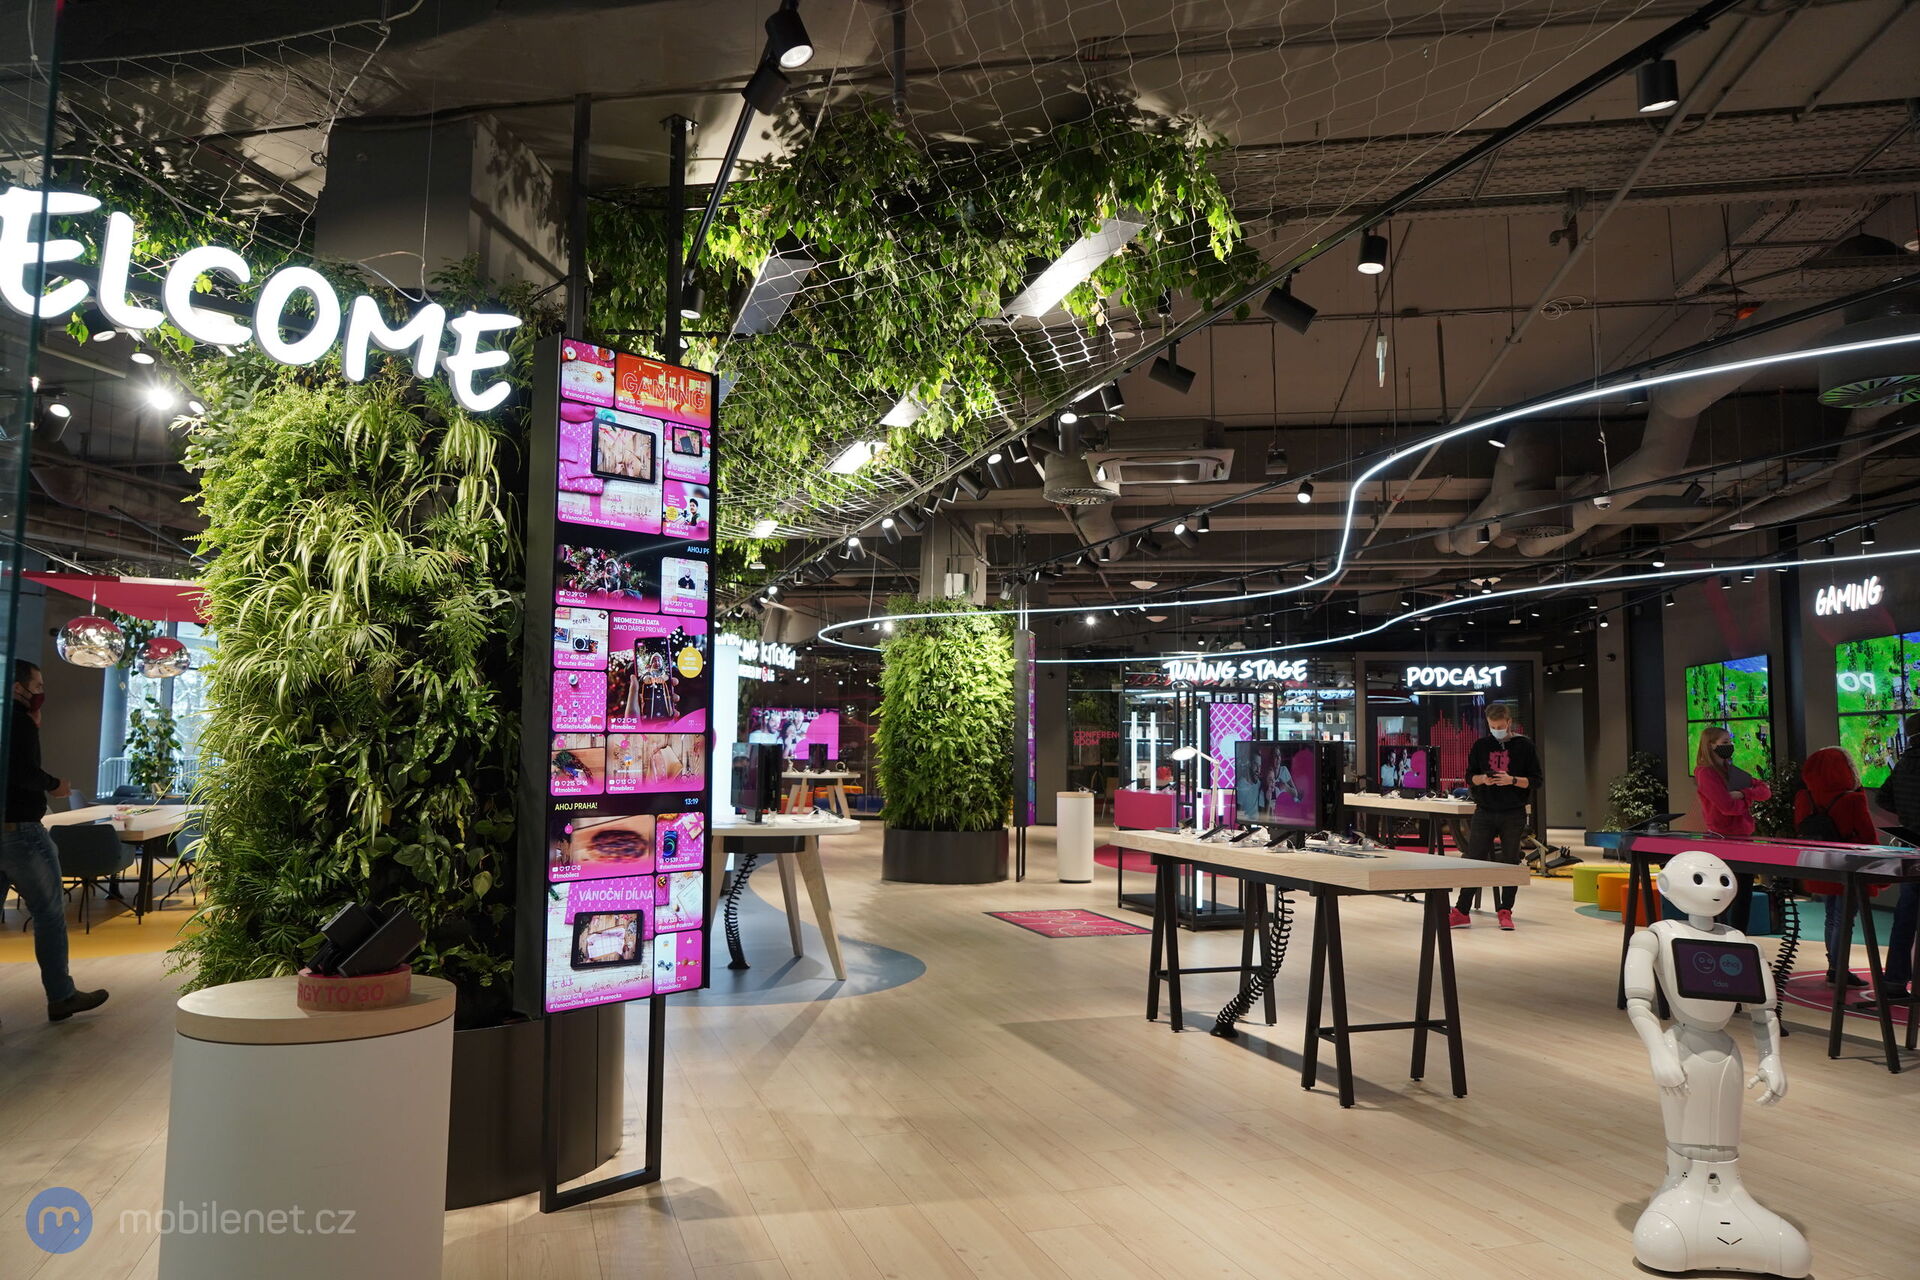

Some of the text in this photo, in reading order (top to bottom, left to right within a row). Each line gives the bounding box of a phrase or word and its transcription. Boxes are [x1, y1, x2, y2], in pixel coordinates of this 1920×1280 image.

[622, 372, 706, 410] GAMING
[687, 546, 702, 554] AHOJ
[1815, 575, 1883, 616] GAMING
[613, 616, 646, 624] NEOMEZENÁ
[1162, 658, 1308, 682] TUNING STAGE
[1406, 665, 1507, 687] PODCAST
[554, 802, 598, 811] AHOJ PRAHA!
[579, 887, 654, 901] VÁNOČNÍ DÍLNA
[324, 985, 352, 1003] TO
[356, 984, 385, 1003] GO
